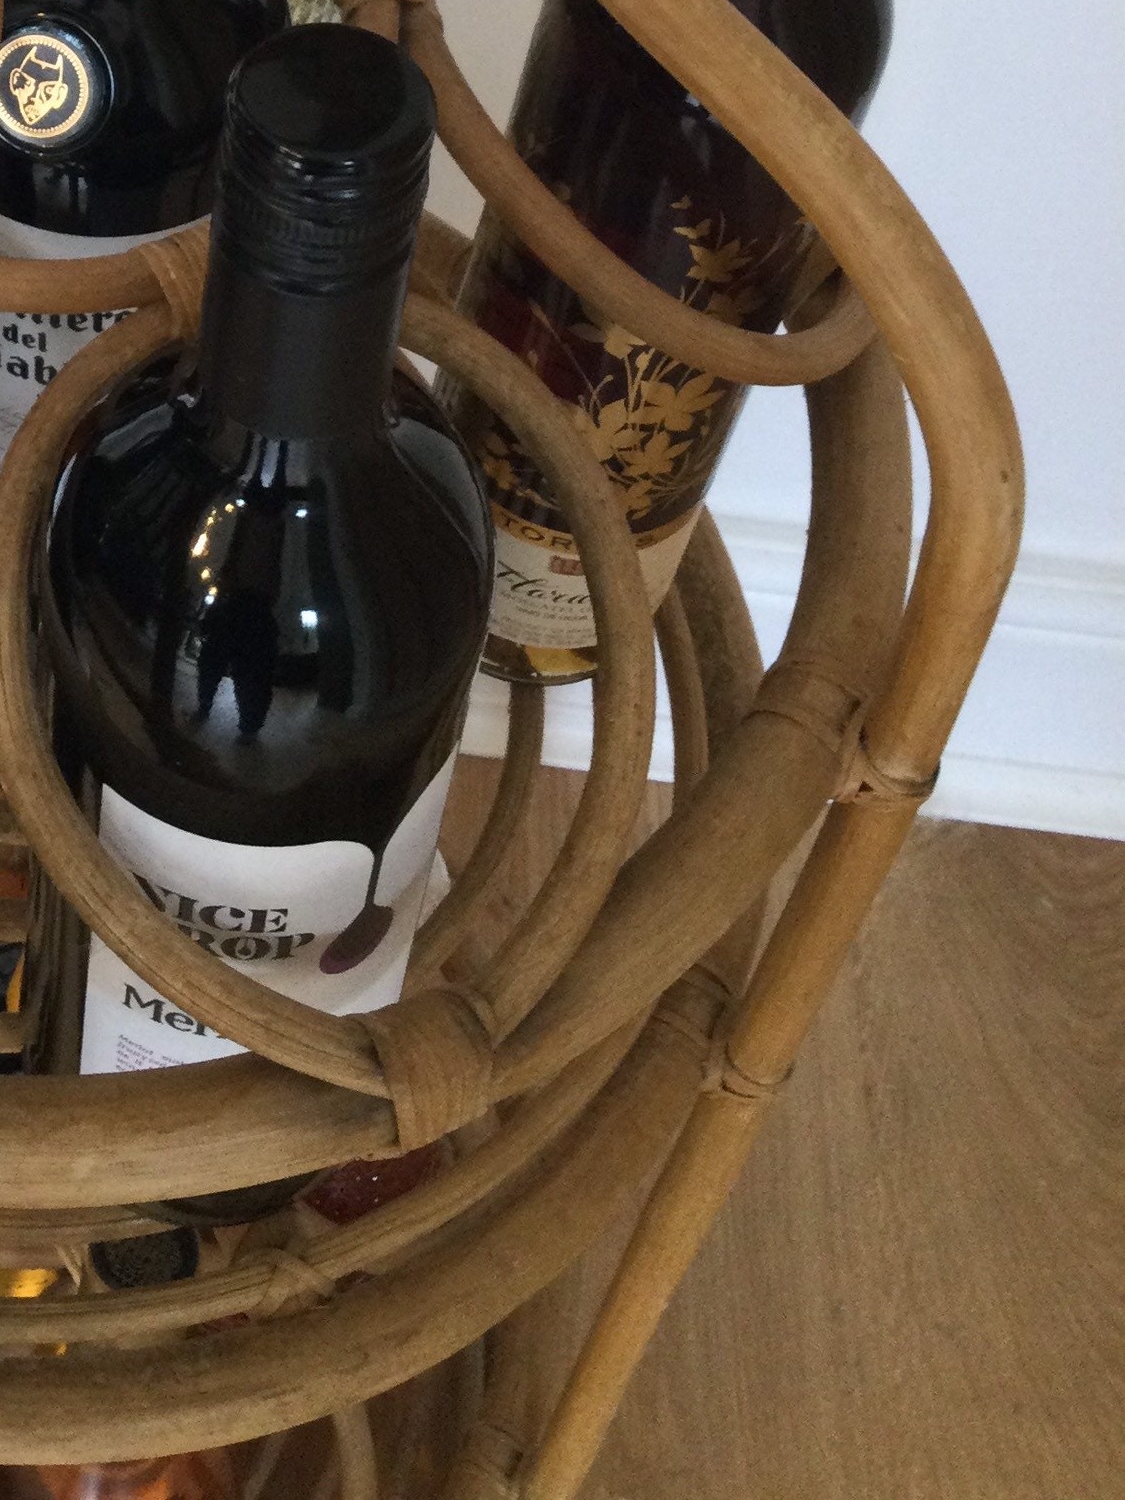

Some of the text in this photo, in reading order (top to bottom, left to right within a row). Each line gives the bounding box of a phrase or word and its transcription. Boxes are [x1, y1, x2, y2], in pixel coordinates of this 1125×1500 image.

[1, 323, 48, 353] del
[177, 923, 316, 961] ROP
[122, 982, 228, 1038] Mer
